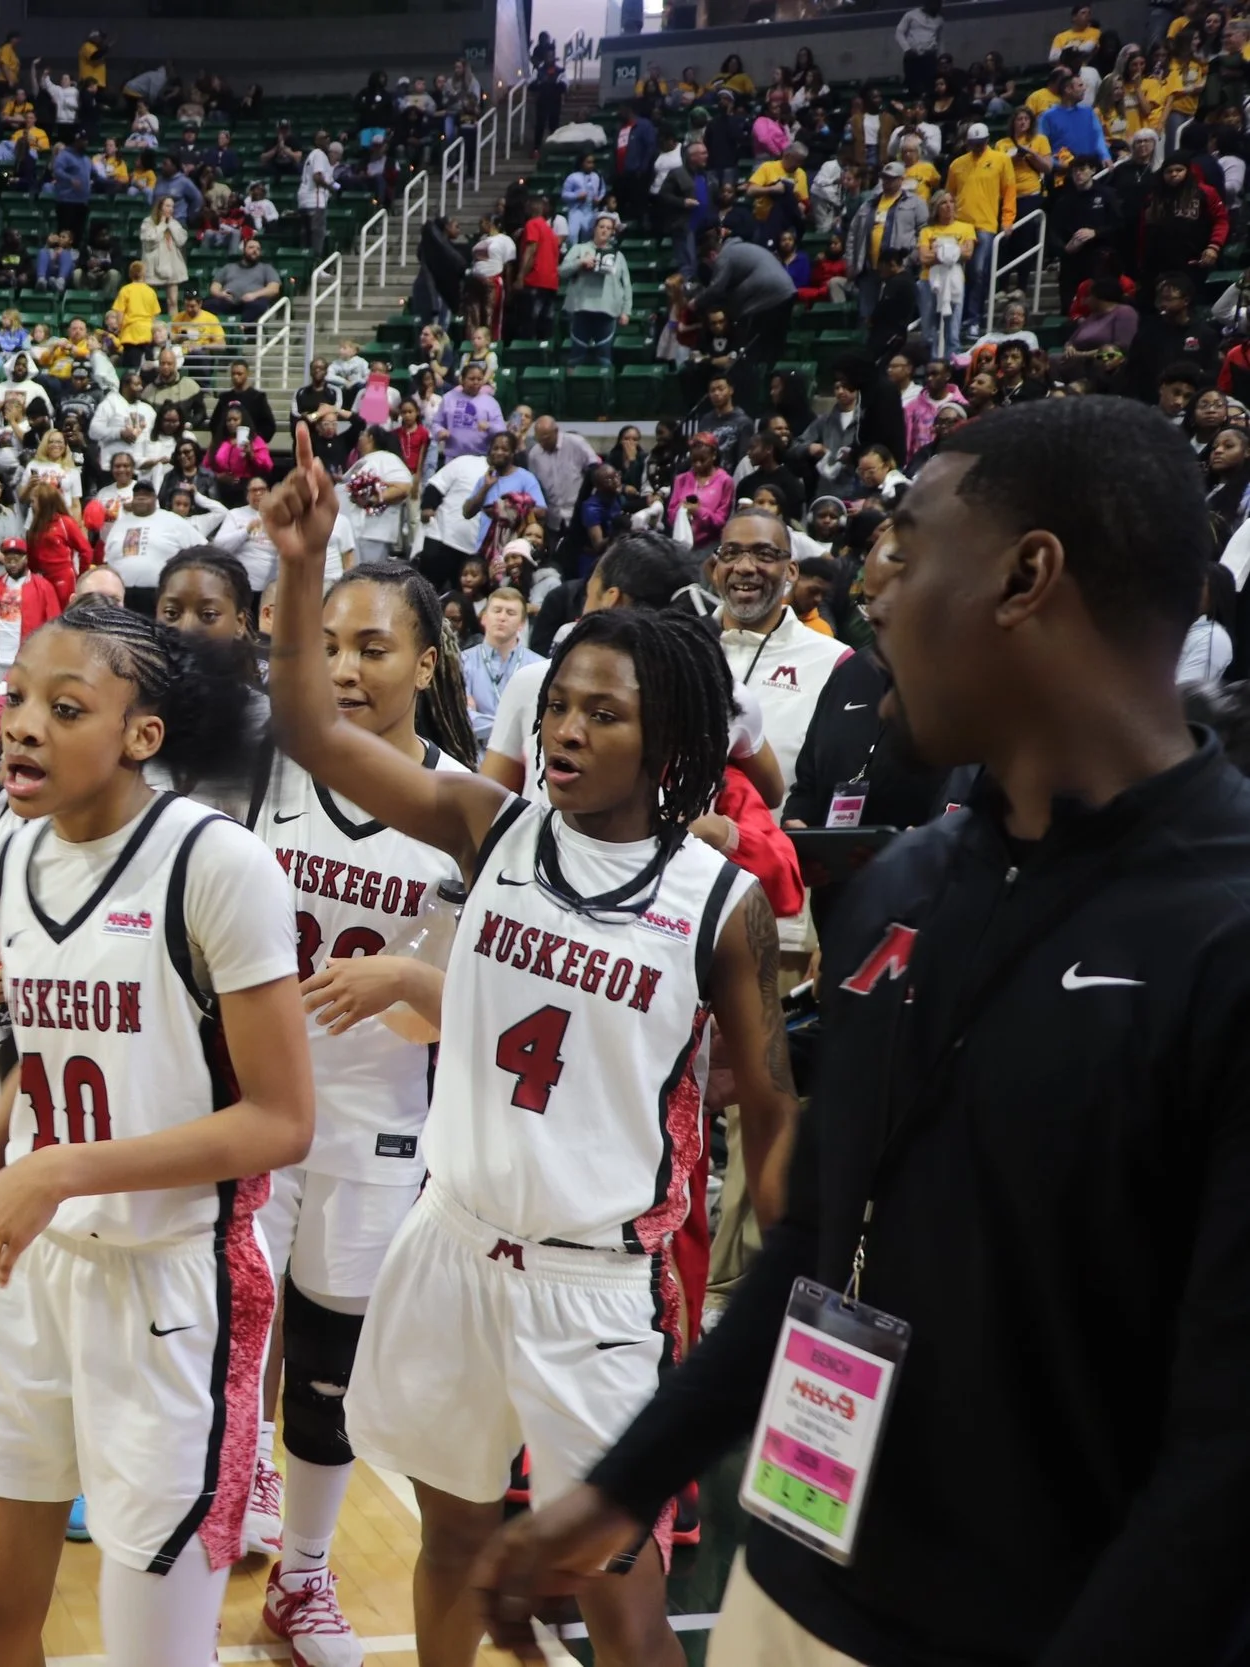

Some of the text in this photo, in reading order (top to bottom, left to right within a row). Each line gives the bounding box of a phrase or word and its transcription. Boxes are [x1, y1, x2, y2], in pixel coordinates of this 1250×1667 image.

[465, 48, 487, 59] 104
[615, 67, 637, 78] 104
[768, 665, 798, 686] M
[275, 847, 427, 918] MUSKEGON
[473, 909, 663, 1014] MUSKEGON
[495, 1003, 572, 1115] 4
[20, 1051, 113, 1153] 10
[486, 1237, 526, 1271] M
